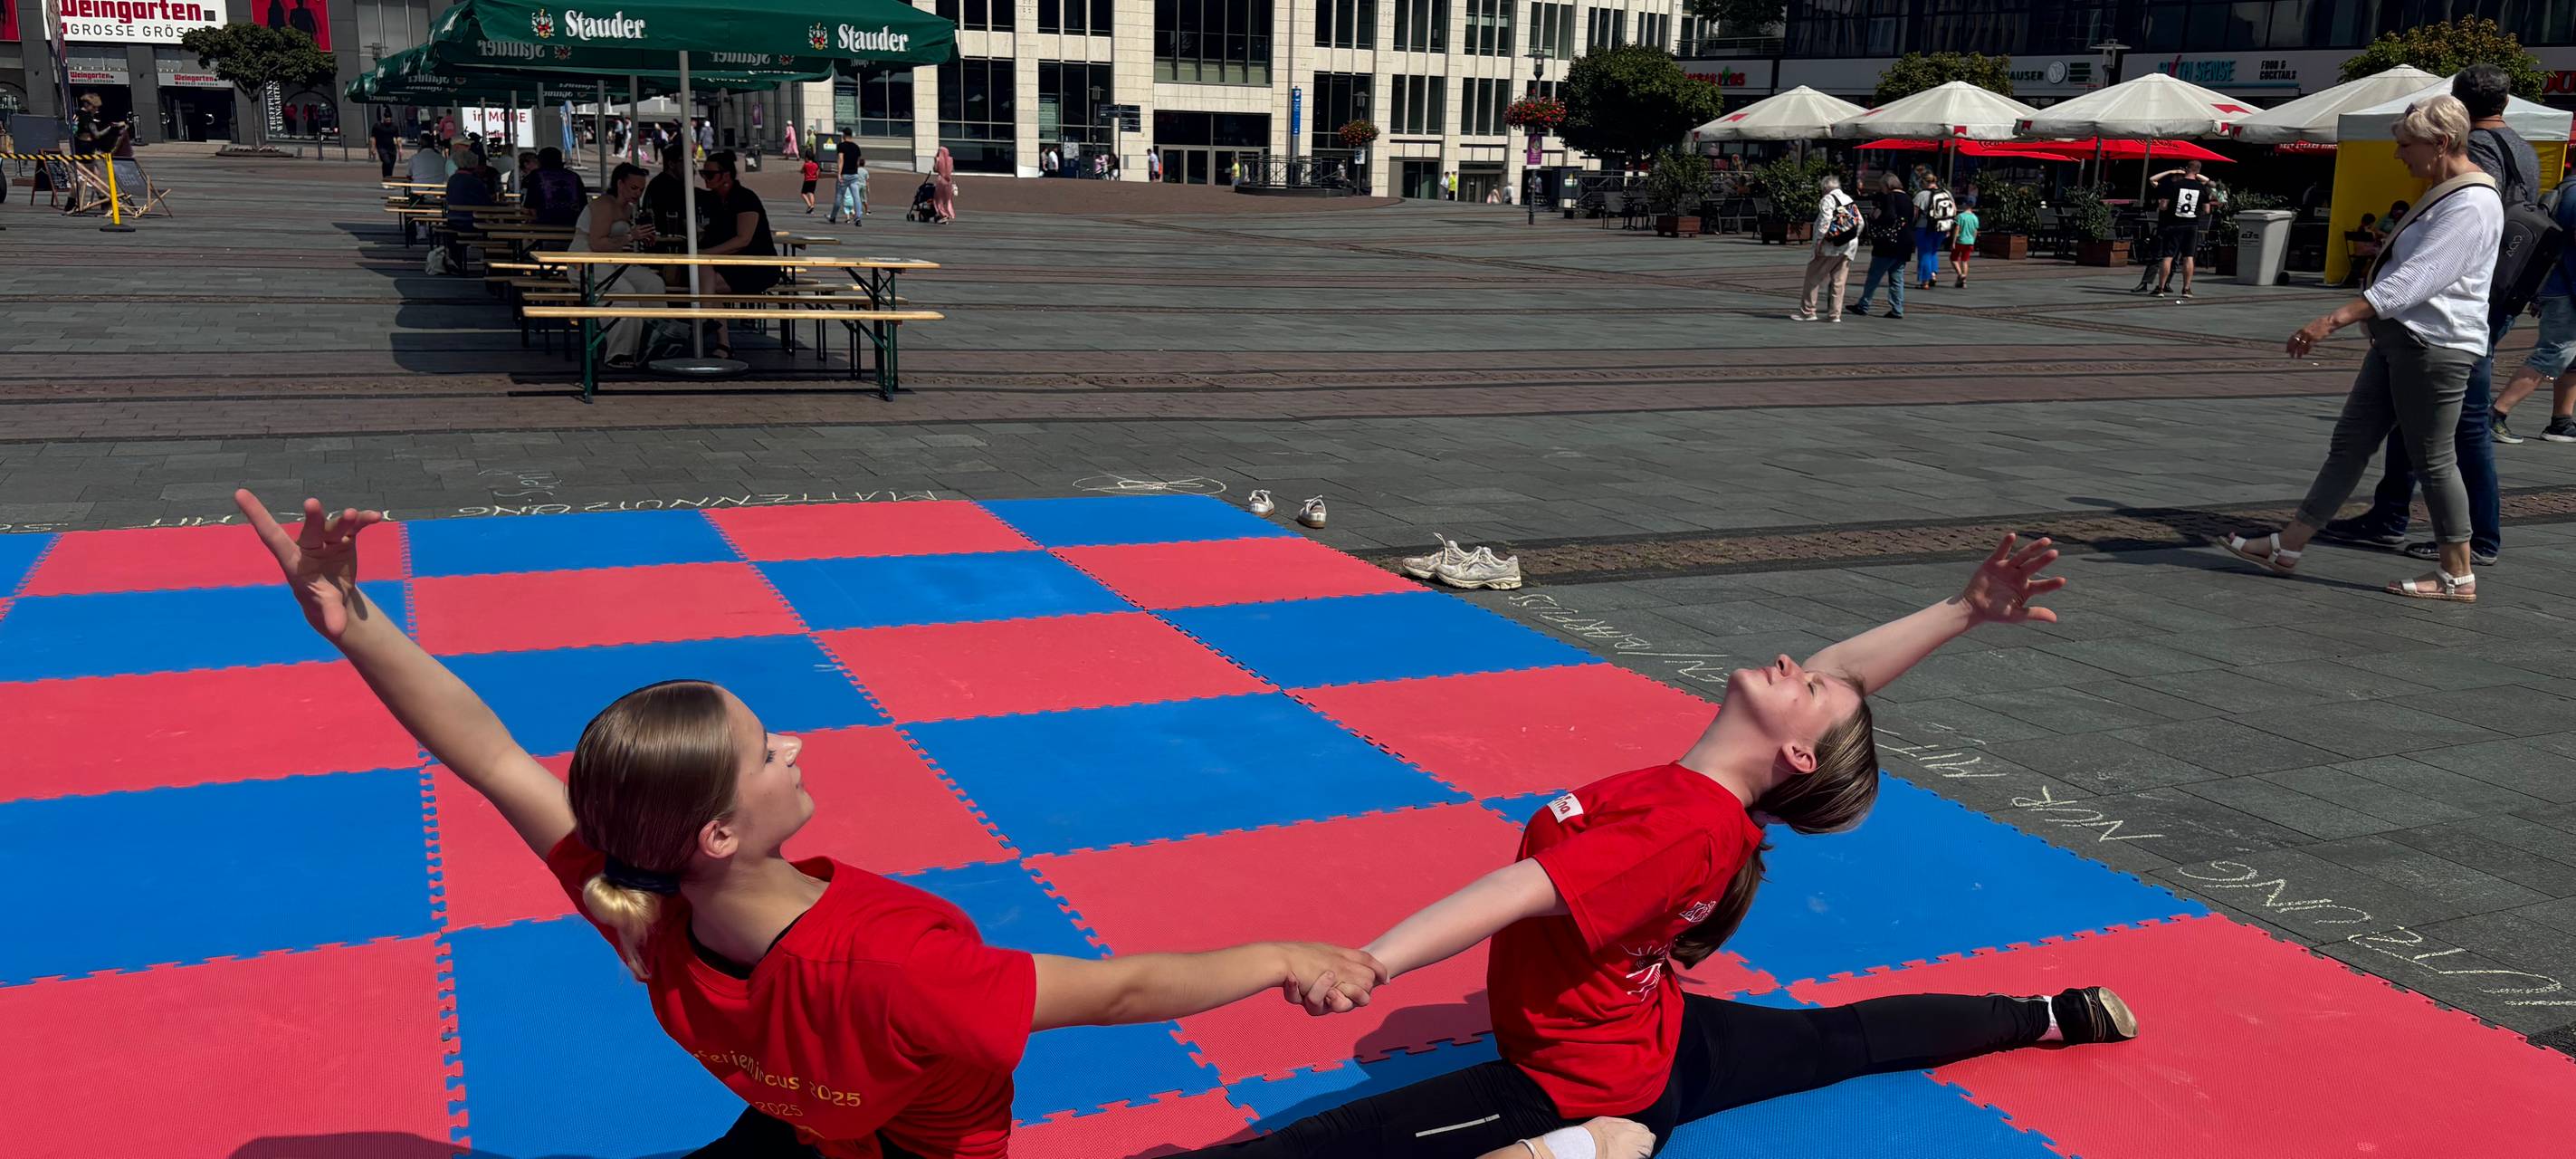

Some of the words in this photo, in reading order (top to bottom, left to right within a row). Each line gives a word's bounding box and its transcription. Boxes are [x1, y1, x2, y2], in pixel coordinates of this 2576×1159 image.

[71, 24, 135, 37] GROSSE
[143, 24, 206, 38] GRÖS
[565, 9, 645, 41] Stauder
[838, 24, 909, 53] Stauder
[2008, 71, 2044, 81] AUSER
[2195, 59, 2237, 82] SENSE
[266, 80, 276, 130] TREFFPUNK
[2010, 784, 2165, 842] NUR
[809, 1080, 861, 1107] 2025
[755, 1101, 804, 1117] 2025
